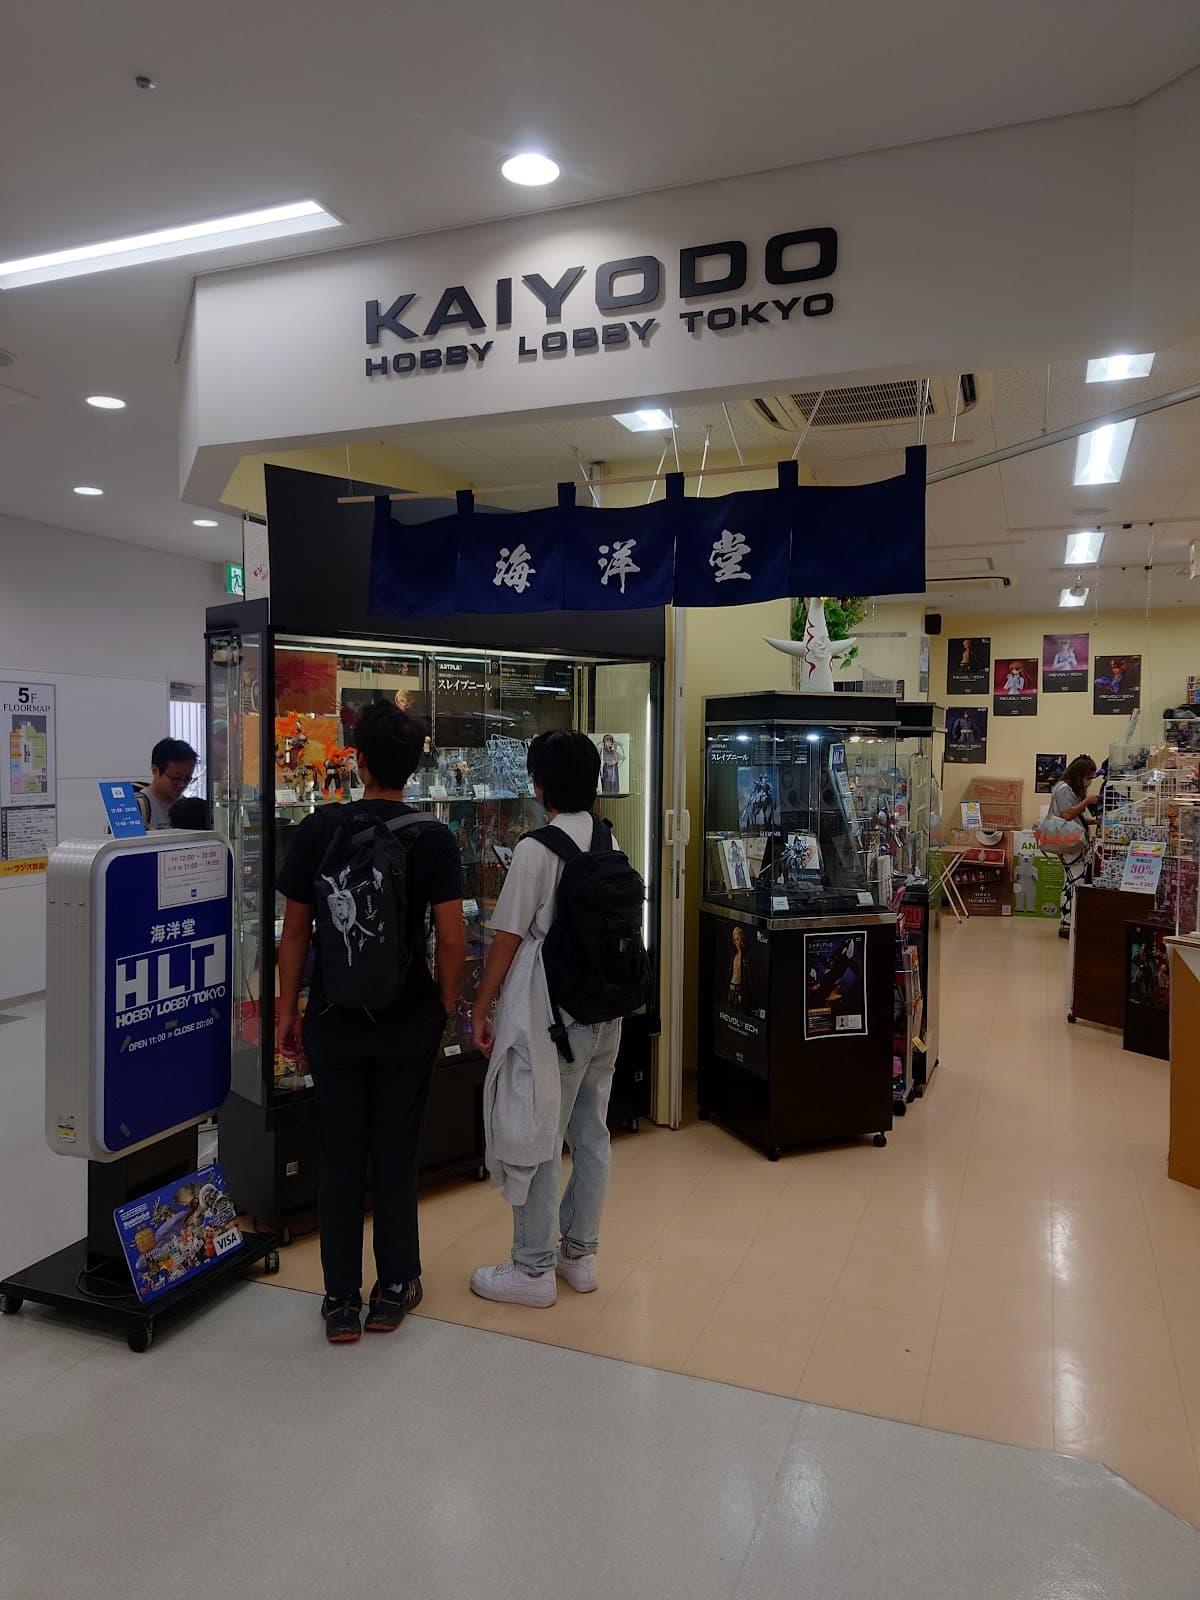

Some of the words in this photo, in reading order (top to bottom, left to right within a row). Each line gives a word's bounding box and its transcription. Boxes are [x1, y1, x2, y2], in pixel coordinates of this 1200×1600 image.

[365, 227, 838, 345] KAIYODO
[365, 340, 494, 376] HOBBY
[518, 318, 656, 356] LOBBY
[679, 292, 834, 333] TOKYO
[492, 529, 752, 593] 海洋堂
[437, 679, 492, 692] スレイプニール
[3, 703, 51, 713] FLOORMAP
[1130, 863, 1154, 875] 30%
[150, 918, 196, 944] 海洋堂
[116, 934, 226, 1013] HLT
[115, 1006, 155, 1029] HOBBY
[157, 995, 191, 1016] LOBBY
[192, 985, 226, 1005] TOKYO
[128, 1039, 148, 1052] OPEN
[148, 1033, 166, 1045] 11:00
[173, 1023, 195, 1037] CLOSE
[196, 1017, 214, 1029] 20:00
[216, 1232, 238, 1250] VISA
